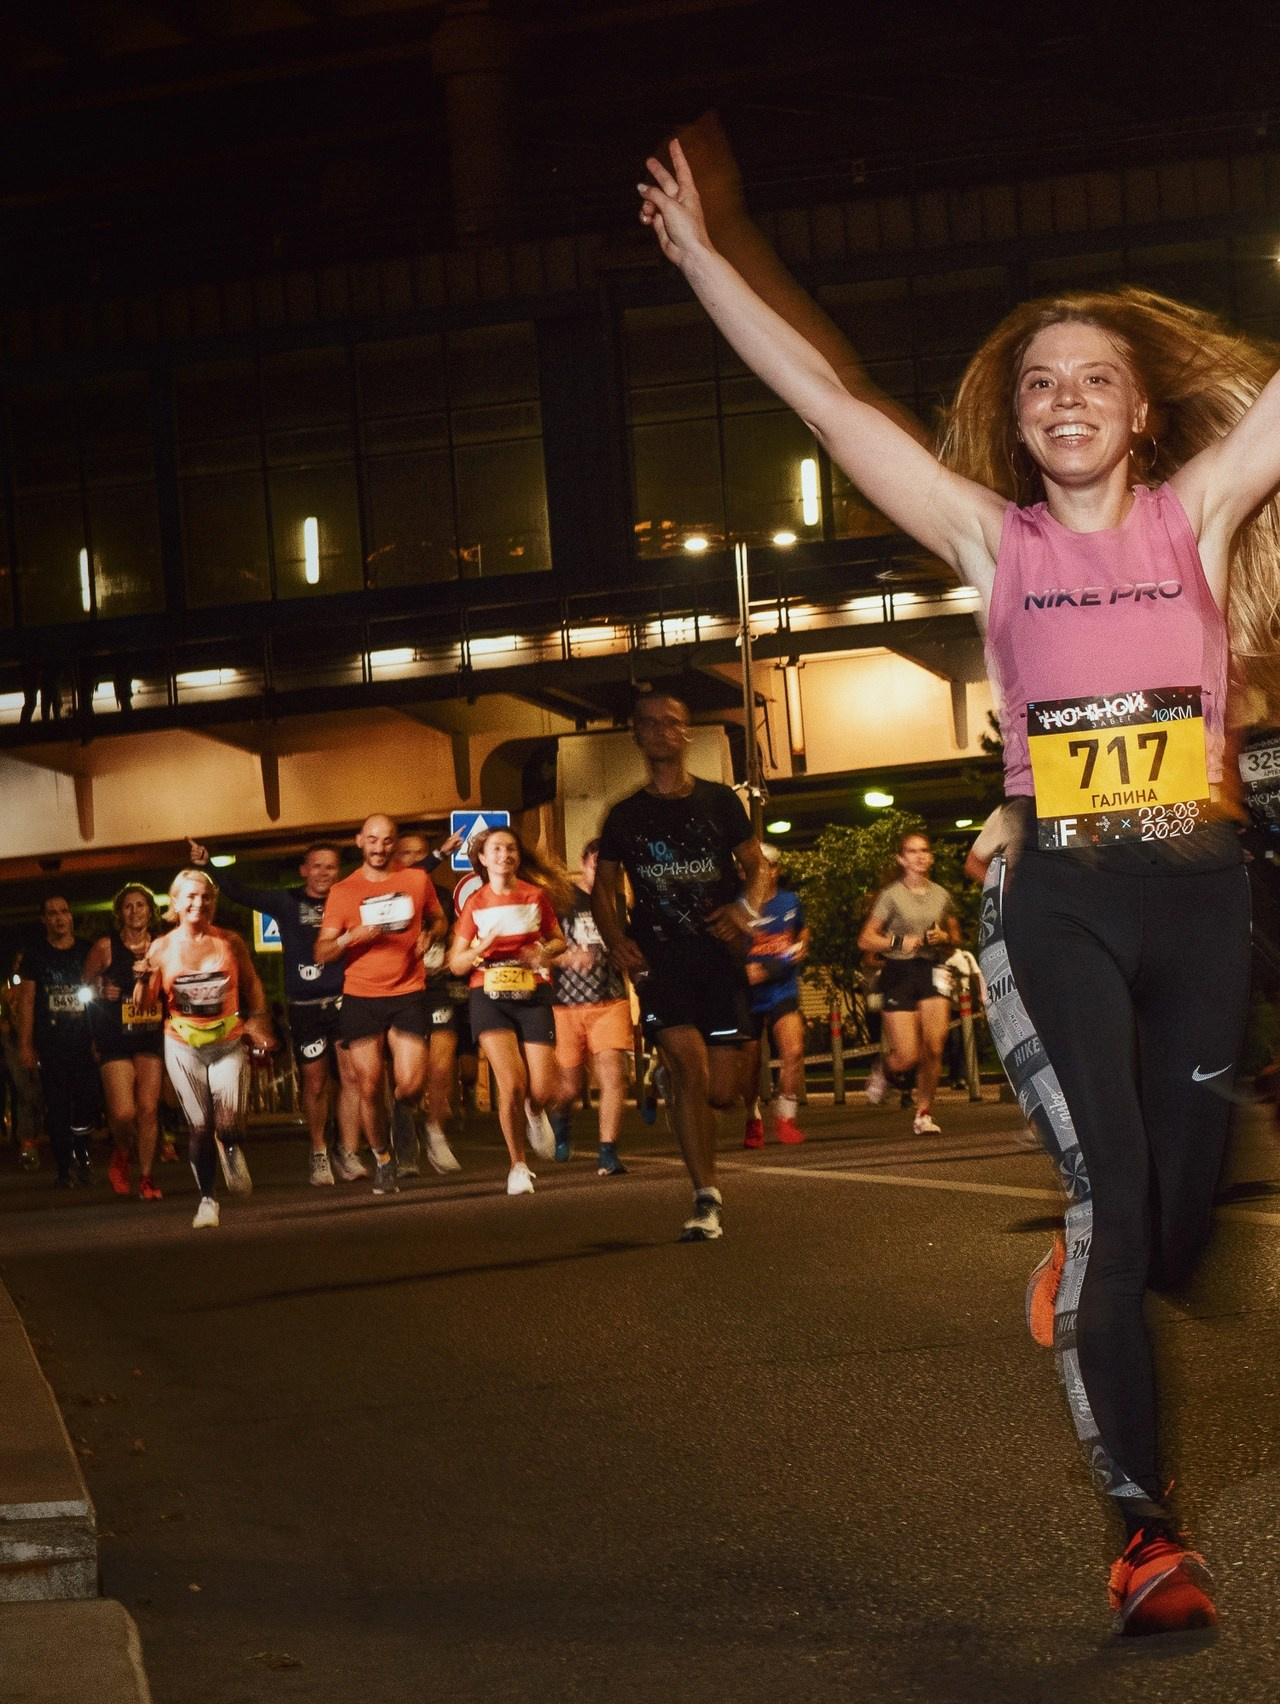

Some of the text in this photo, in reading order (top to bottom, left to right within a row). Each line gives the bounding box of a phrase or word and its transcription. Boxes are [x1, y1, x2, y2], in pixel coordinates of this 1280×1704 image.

[1024, 579, 1183, 611] NIKE PRO
[1091, 715, 1132, 729] ЗАБЕГ
[1068, 730, 1168, 789] 717
[1091, 788, 1158, 809] ГАЛИНА
[1059, 818, 1078, 847] F
[1141, 817, 1195, 842] 2020
[648, 841, 666, 857] 10
[1014, 1037, 1041, 1068] NIKE
